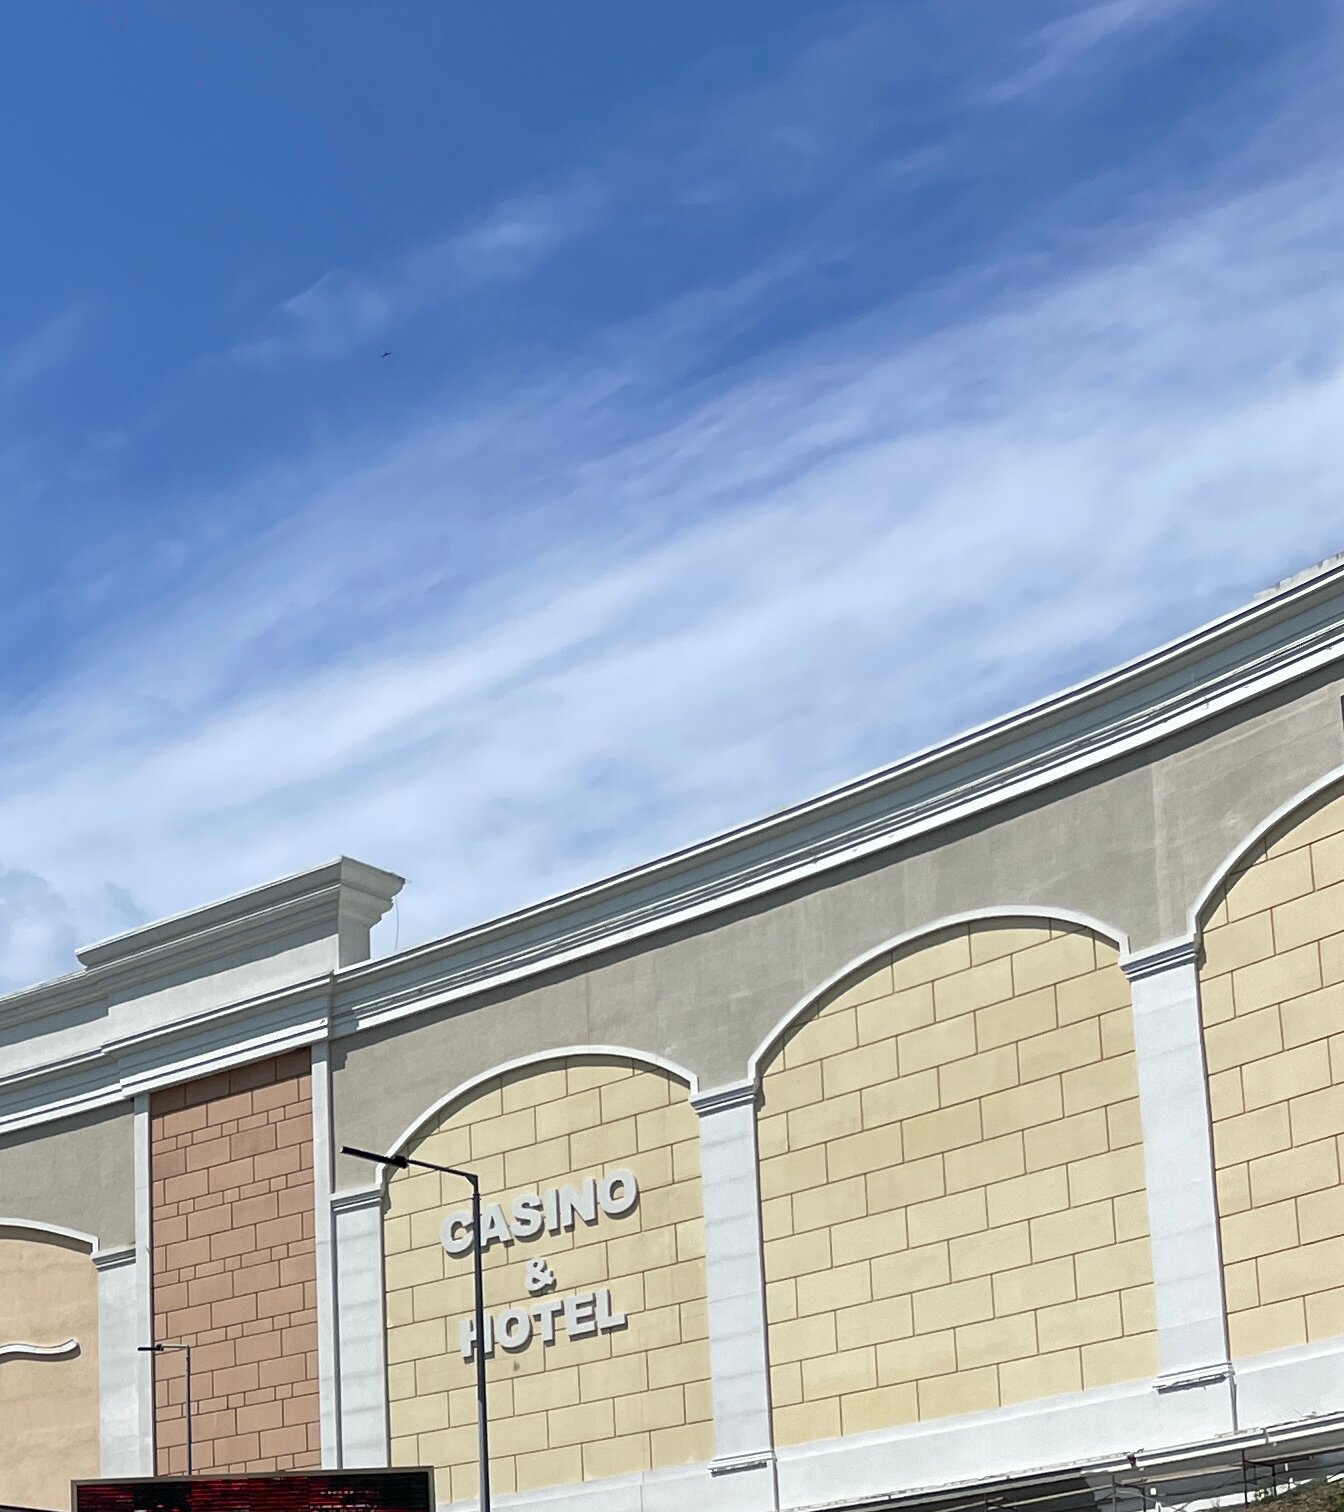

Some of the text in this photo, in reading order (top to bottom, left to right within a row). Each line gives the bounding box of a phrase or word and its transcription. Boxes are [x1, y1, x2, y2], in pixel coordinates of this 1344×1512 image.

[439, 1168, 638, 1256] CASINO
[524, 1257, 555, 1292] &
[459, 1289, 627, 1359] HOTEL
